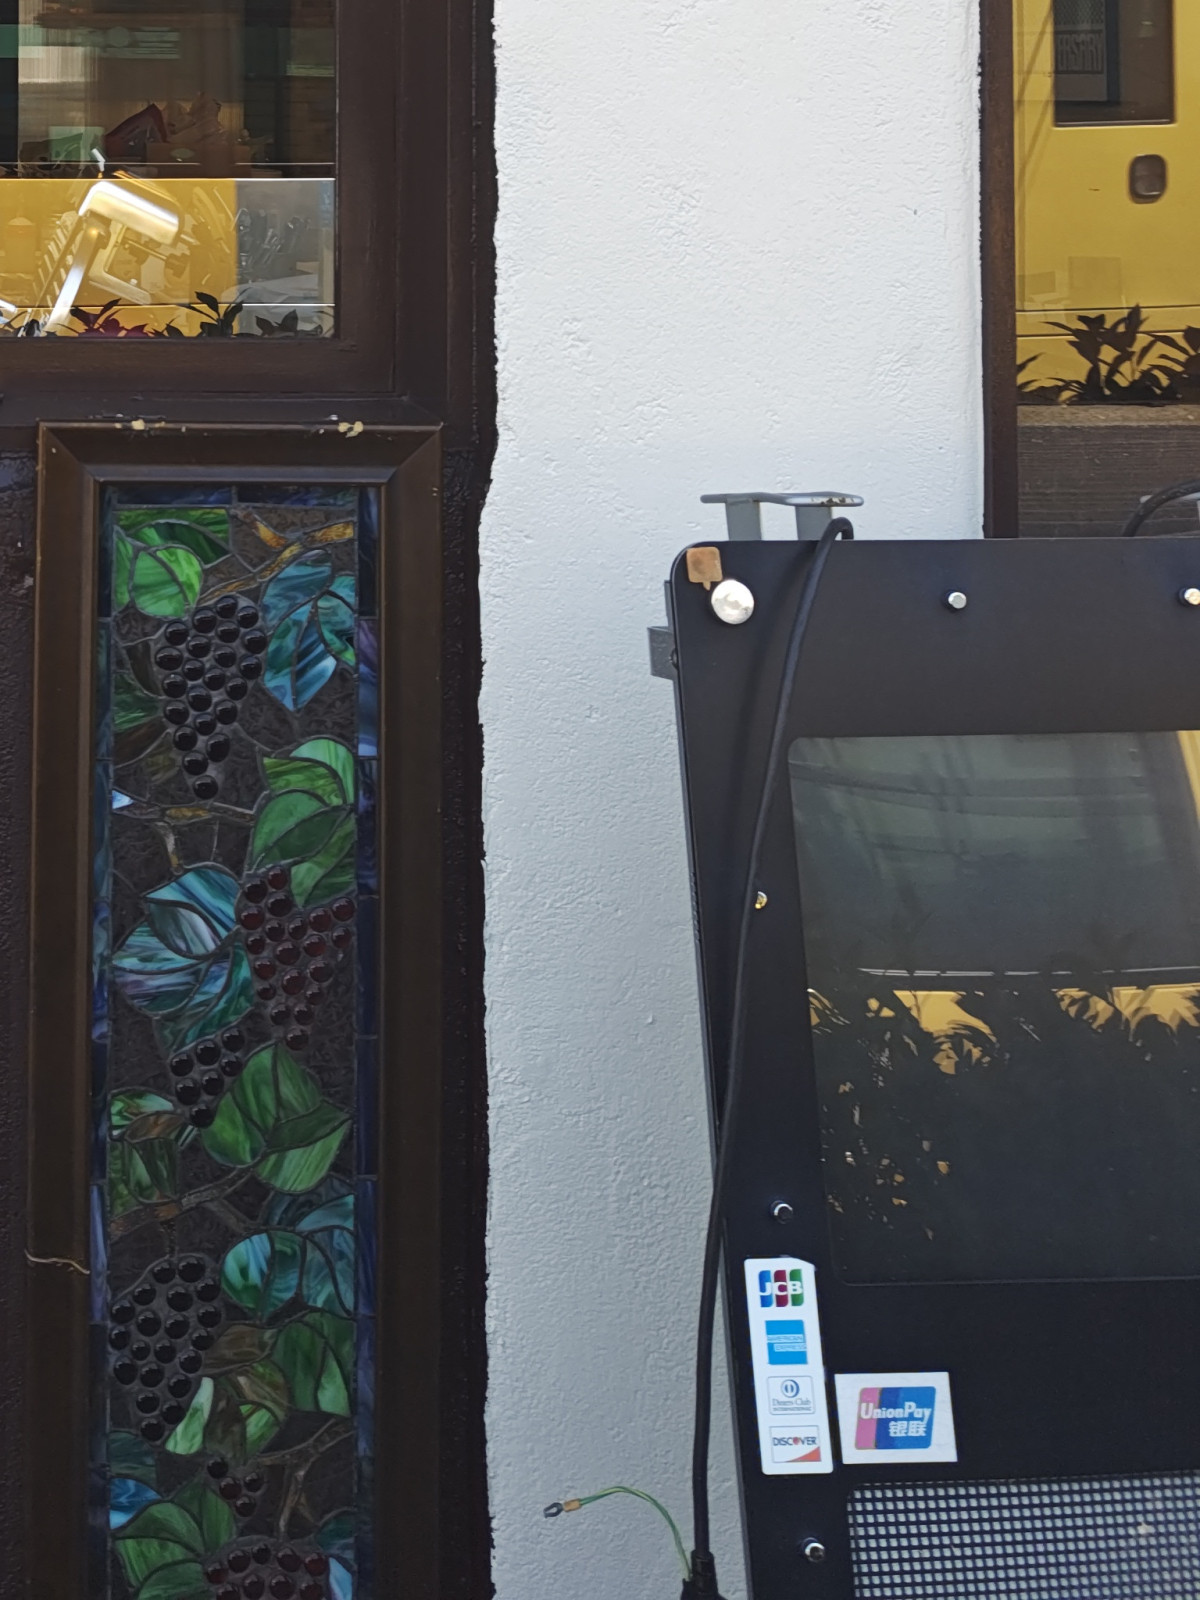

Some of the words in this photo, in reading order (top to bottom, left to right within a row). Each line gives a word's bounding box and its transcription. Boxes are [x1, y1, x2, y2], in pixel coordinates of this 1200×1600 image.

[759, 1281, 804, 1296] JCB
[860, 1402, 932, 1423] UnionPay
[772, 1437, 817, 1446] DISCOVER
